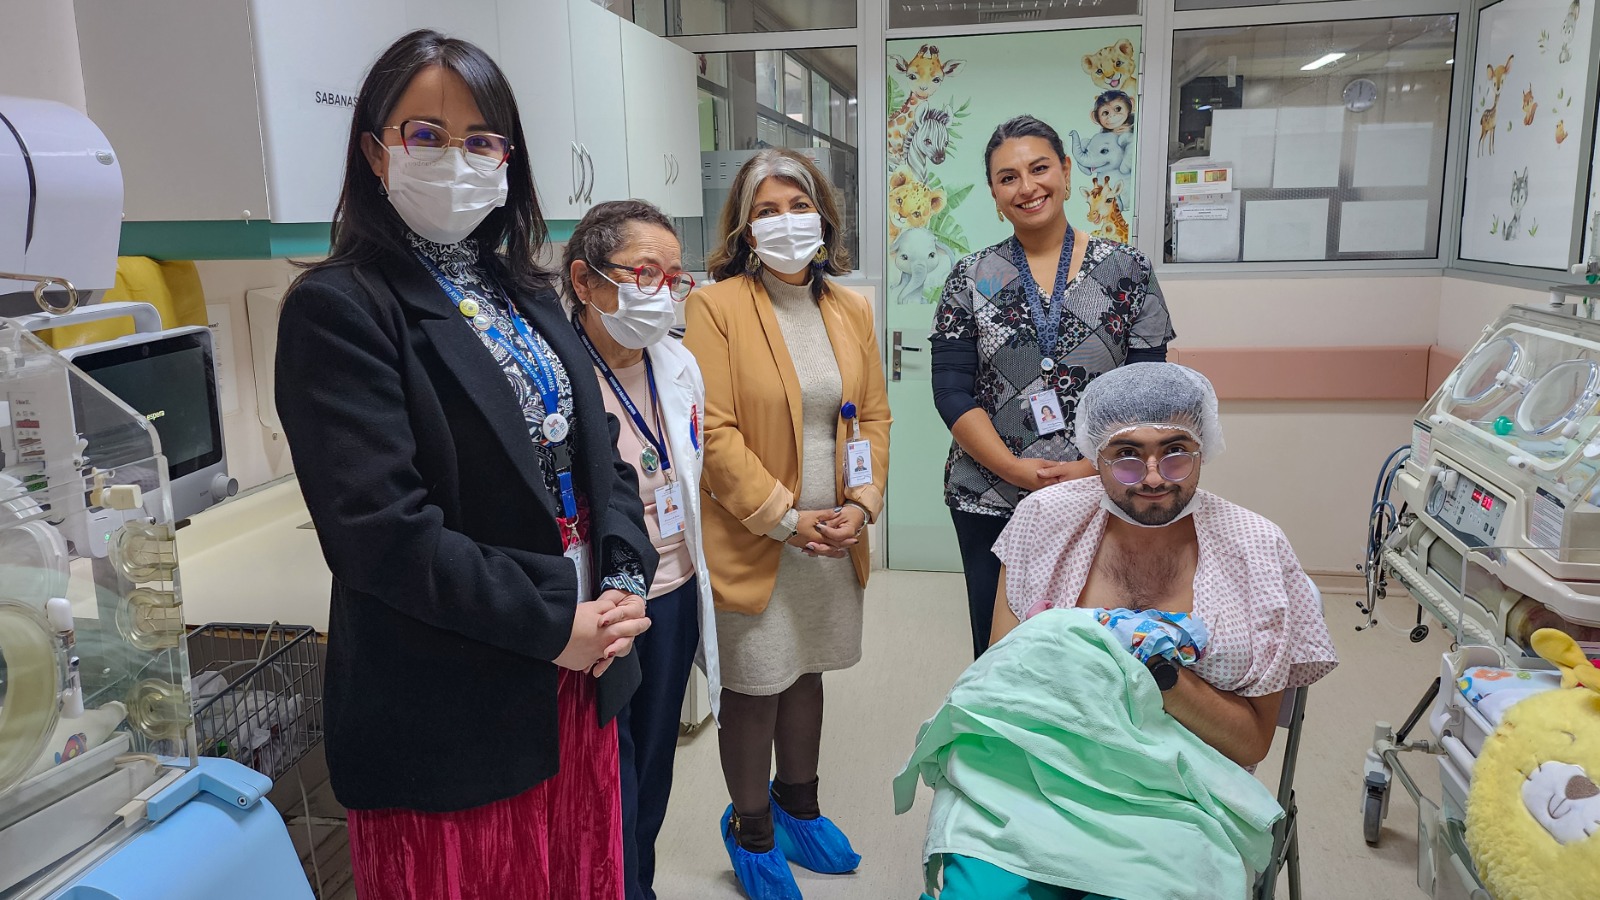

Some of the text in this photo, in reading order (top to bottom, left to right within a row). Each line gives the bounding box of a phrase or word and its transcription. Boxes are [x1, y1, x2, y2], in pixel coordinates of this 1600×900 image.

[315, 91, 360, 108] SABANAS
[435, 276, 453, 293] SALUD
[523, 362, 538, 379] SALUD
